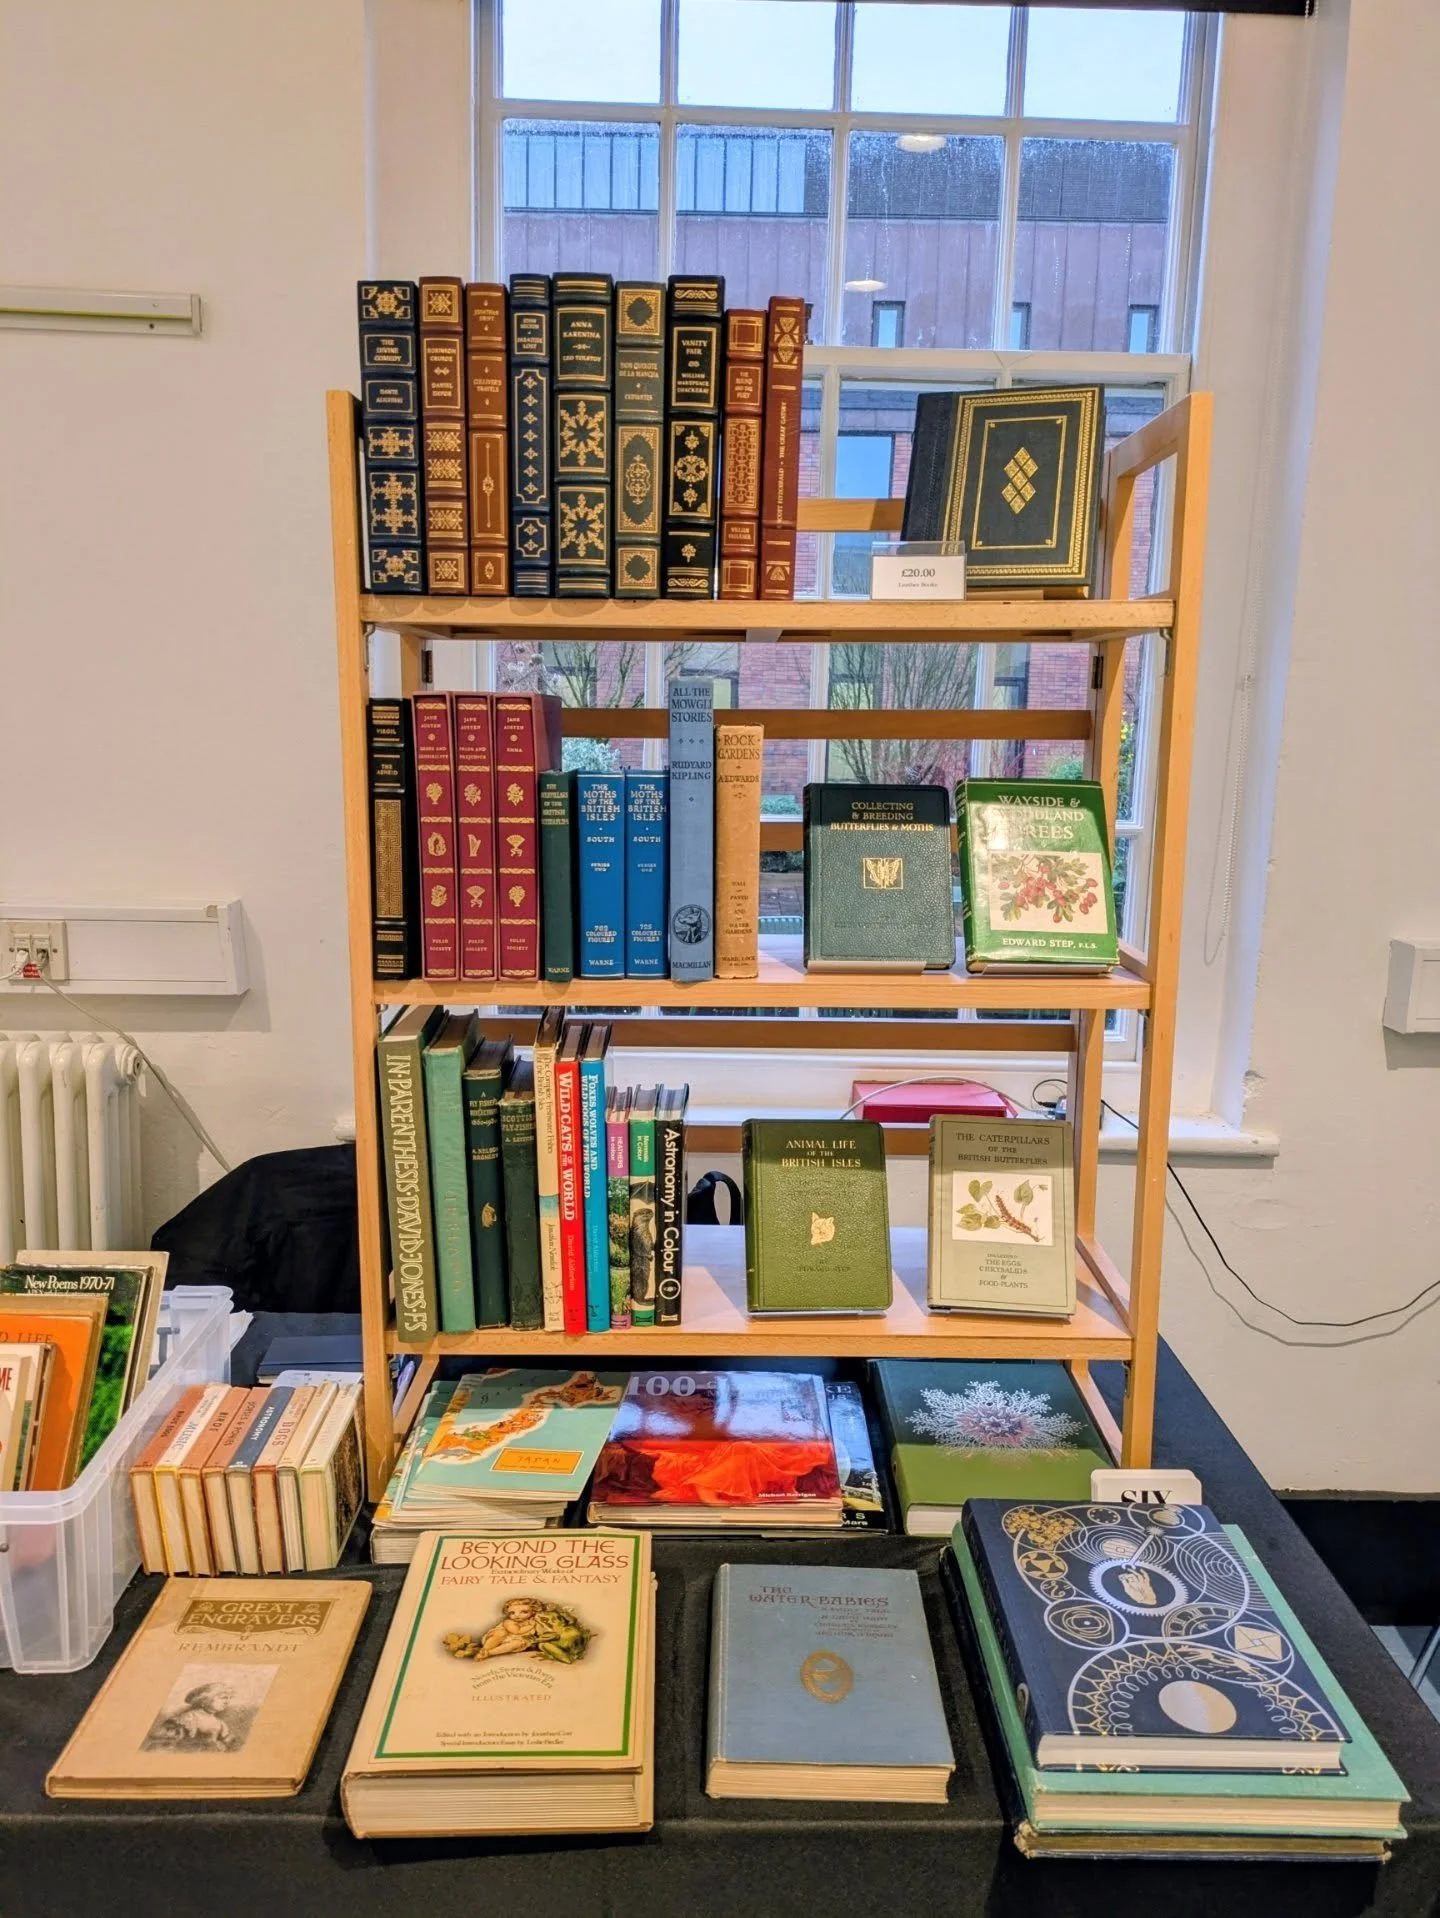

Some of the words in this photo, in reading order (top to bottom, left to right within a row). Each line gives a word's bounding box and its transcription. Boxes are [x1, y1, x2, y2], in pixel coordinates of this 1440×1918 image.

[901, 568, 936, 578] £20.00
[673, 688, 692, 697] ALL
[694, 688, 711, 697] THE
[672, 699, 712, 710] MOWGLI
[672, 712, 712, 722] STORIES
[724, 734, 754, 746] ROCK
[717, 748, 760, 760] GARDENS
[672, 760, 712, 769] RUDYARD
[671, 772, 712, 780] KIPLING
[584, 790, 616, 798] MOTHS
[630, 790, 664, 798] MOTHS
[852, 802, 914, 810] COLLECTING
[998, 795, 1064, 808] WAYSIDE
[1069, 798, 1080, 808] &
[852, 812, 860, 820] &
[862, 812, 914, 820] BREEDING
[830, 822, 890, 832] BUTTERFLIES
[900, 823, 934, 832] MOTHS
[1002, 938, 1046, 948] EDWARD
[672, 961, 711, 969] MACMILLAN
[386, 1054, 411, 1074] IN
[559, 1071, 573, 1112] WILD
[588, 1074, 599, 1111] FOXES,
[388, 1078, 420, 1192] PARENTHESIS
[560, 1113, 574, 1152] CATS
[583, 1126, 589, 1136] OF
[589, 1112, 598, 1149] WOLVES
[956, 1132, 975, 1142] THE
[978, 1134, 1050, 1146] CATERPILLARS
[786, 1140, 828, 1150] ANIMAL
[832, 1140, 856, 1150] LIFE
[1001, 1146, 1017, 1154] THE
[567, 1156, 573, 1164] OF
[590, 1150, 598, 1170] AND
[782, 1158, 825, 1168] BRITISH
[832, 1158, 861, 1168] ISLES
[958, 1154, 992, 1162] BRITISH
[994, 1155, 1048, 1166] BUTTERFLIES
[660, 1128, 680, 1207] Astronomy
[562, 1168, 575, 1220] WORLD
[664, 1210, 680, 1222] in
[396, 1194, 424, 1254] DAVID
[663, 1227, 680, 1274] Colour
[984, 1258, 1000, 1266] THE
[978, 1266, 1028, 1275] CHRYSALIDS
[24, 1275, 46, 1289] New
[46, 1275, 79, 1290] Poems
[79, 1276, 116, 1291] 1970-71
[400, 1252, 427, 1309] JONES
[978, 1280, 1029, 1289] FOOD-PLANTS
[18, 1332, 53, 1343] LIFE
[626, 1376, 696, 1397] 100
[210, 1412, 229, 1432] BIRDS
[250, 1406, 276, 1441] ASTRONOMY
[172, 1420, 199, 1450] MUSIC
[272, 1422, 296, 1446] DOGS
[518, 1456, 561, 1464] JAPAN
[460, 1540, 557, 1554] BEYOND
[565, 1540, 616, 1554] THE
[440, 1556, 548, 1570] LOOKING
[556, 1556, 629, 1569] GLASS
[440, 1575, 482, 1585] FAIRY
[491, 1575, 527, 1584] TALE
[532, 1574, 546, 1584] &
[551, 1574, 623, 1584] FANTASY
[760, 1585, 792, 1594] THE
[220, 1602, 299, 1614] GREAT
[185, 1614, 322, 1625] ENGRAVERS
[178, 1642, 304, 1652] REMBRANDT
[472, 1694, 552, 1702] ILLUSTRATED
